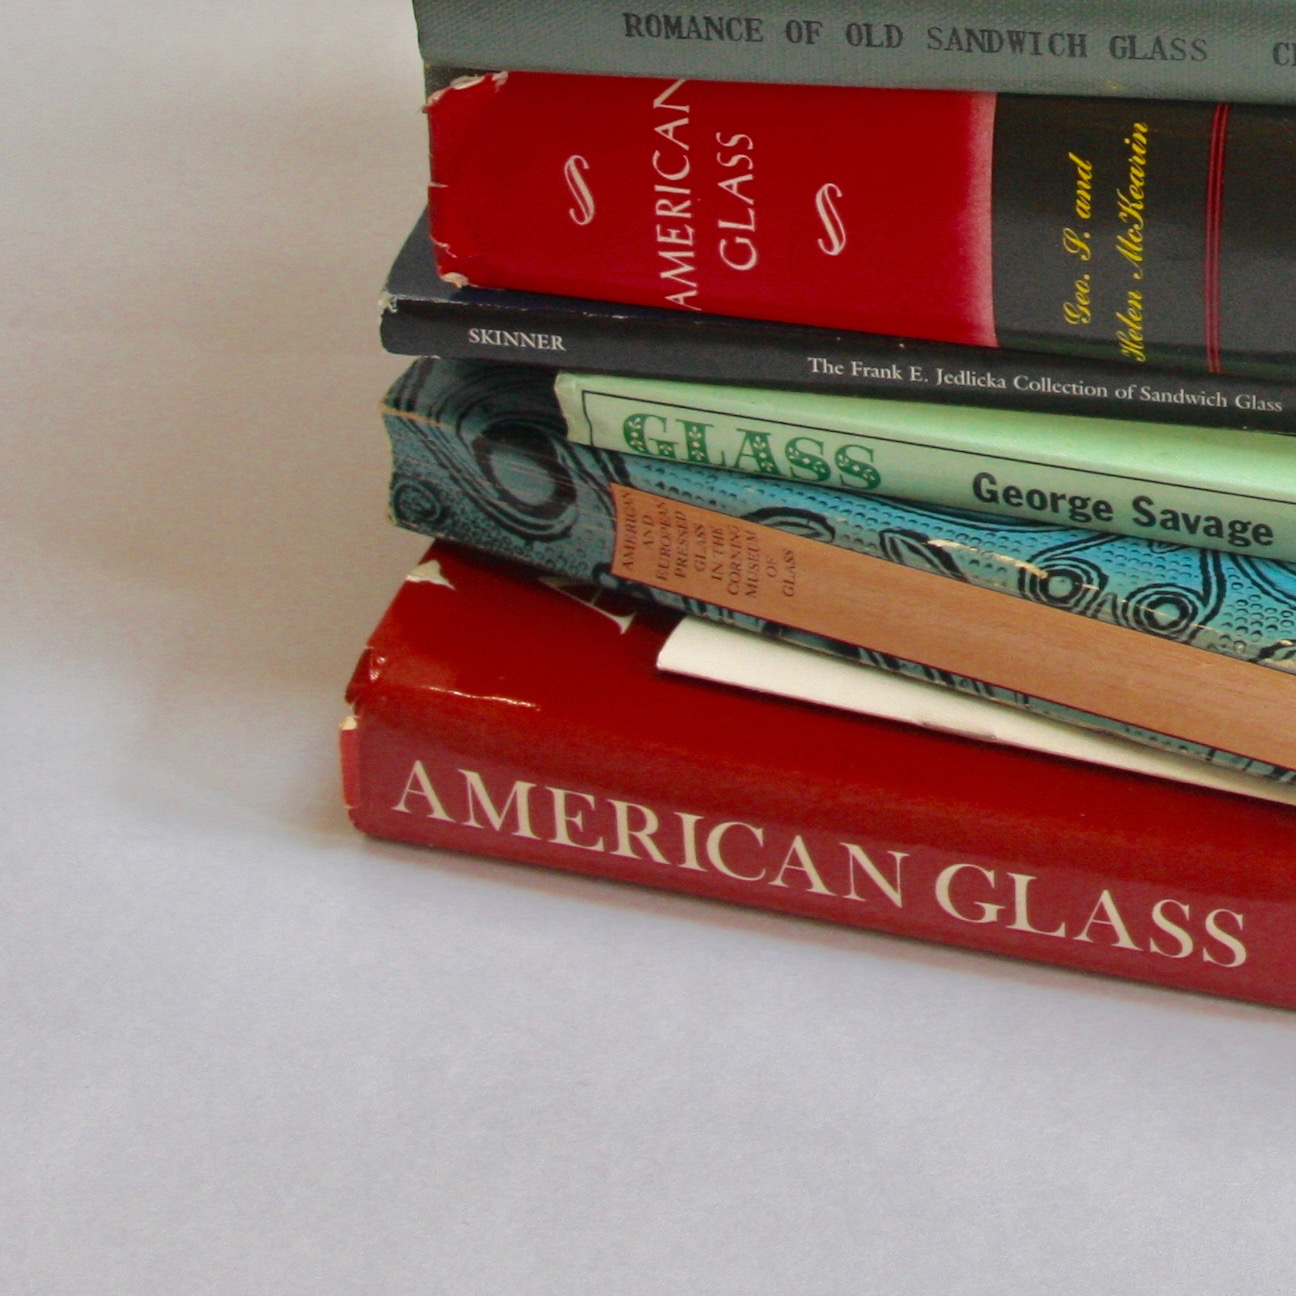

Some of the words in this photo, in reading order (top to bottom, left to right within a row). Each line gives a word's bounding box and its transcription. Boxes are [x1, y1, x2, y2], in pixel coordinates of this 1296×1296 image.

[623, 12, 764, 43] ROMANCE
[785, 20, 823, 46] OF
[845, 23, 903, 49] OLD
[926, 27, 1088, 58] SANDWICH
[1109, 34, 1209, 63] GLASS
[652, 78, 703, 313] AMERICAN
[718, 131, 758, 272] GLASS
[1068, 151, 1093, 219] and
[1115, 121, 1149, 279] McKearin
[469, 328, 566, 352] SKINNER
[1115, 291, 1147, 362] Helen
[807, 357, 844, 376] The
[851, 361, 902, 381] Frank
[910, 366, 929, 384] E.
[935, 367, 1006, 390] Jedlicka
[1013, 376, 1108, 399] Collection
[1115, 385, 1138, 401] of
[1140, 386, 1228, 409] Sandwich
[1235, 394, 1283, 413] Glass
[622, 412, 883, 491] GLASS
[622, 490, 638, 572] AMERICAN
[642, 514, 655, 546] AND
[712, 527, 724, 556] THE
[972, 471, 1115, 525] George
[1131, 494, 1275, 547] Savage
[675, 510, 688, 579] PRESSED
[693, 523, 707, 572] GLASS
[711, 563, 724, 581] IN
[727, 524, 742, 595] CORNING
[745, 530, 760, 598] MUSEUM
[766, 557, 778, 578] OF
[782, 549, 797, 597] GLASS
[391, 759, 911, 910] AMERICAN
[934, 863, 1249, 970] GLASS
